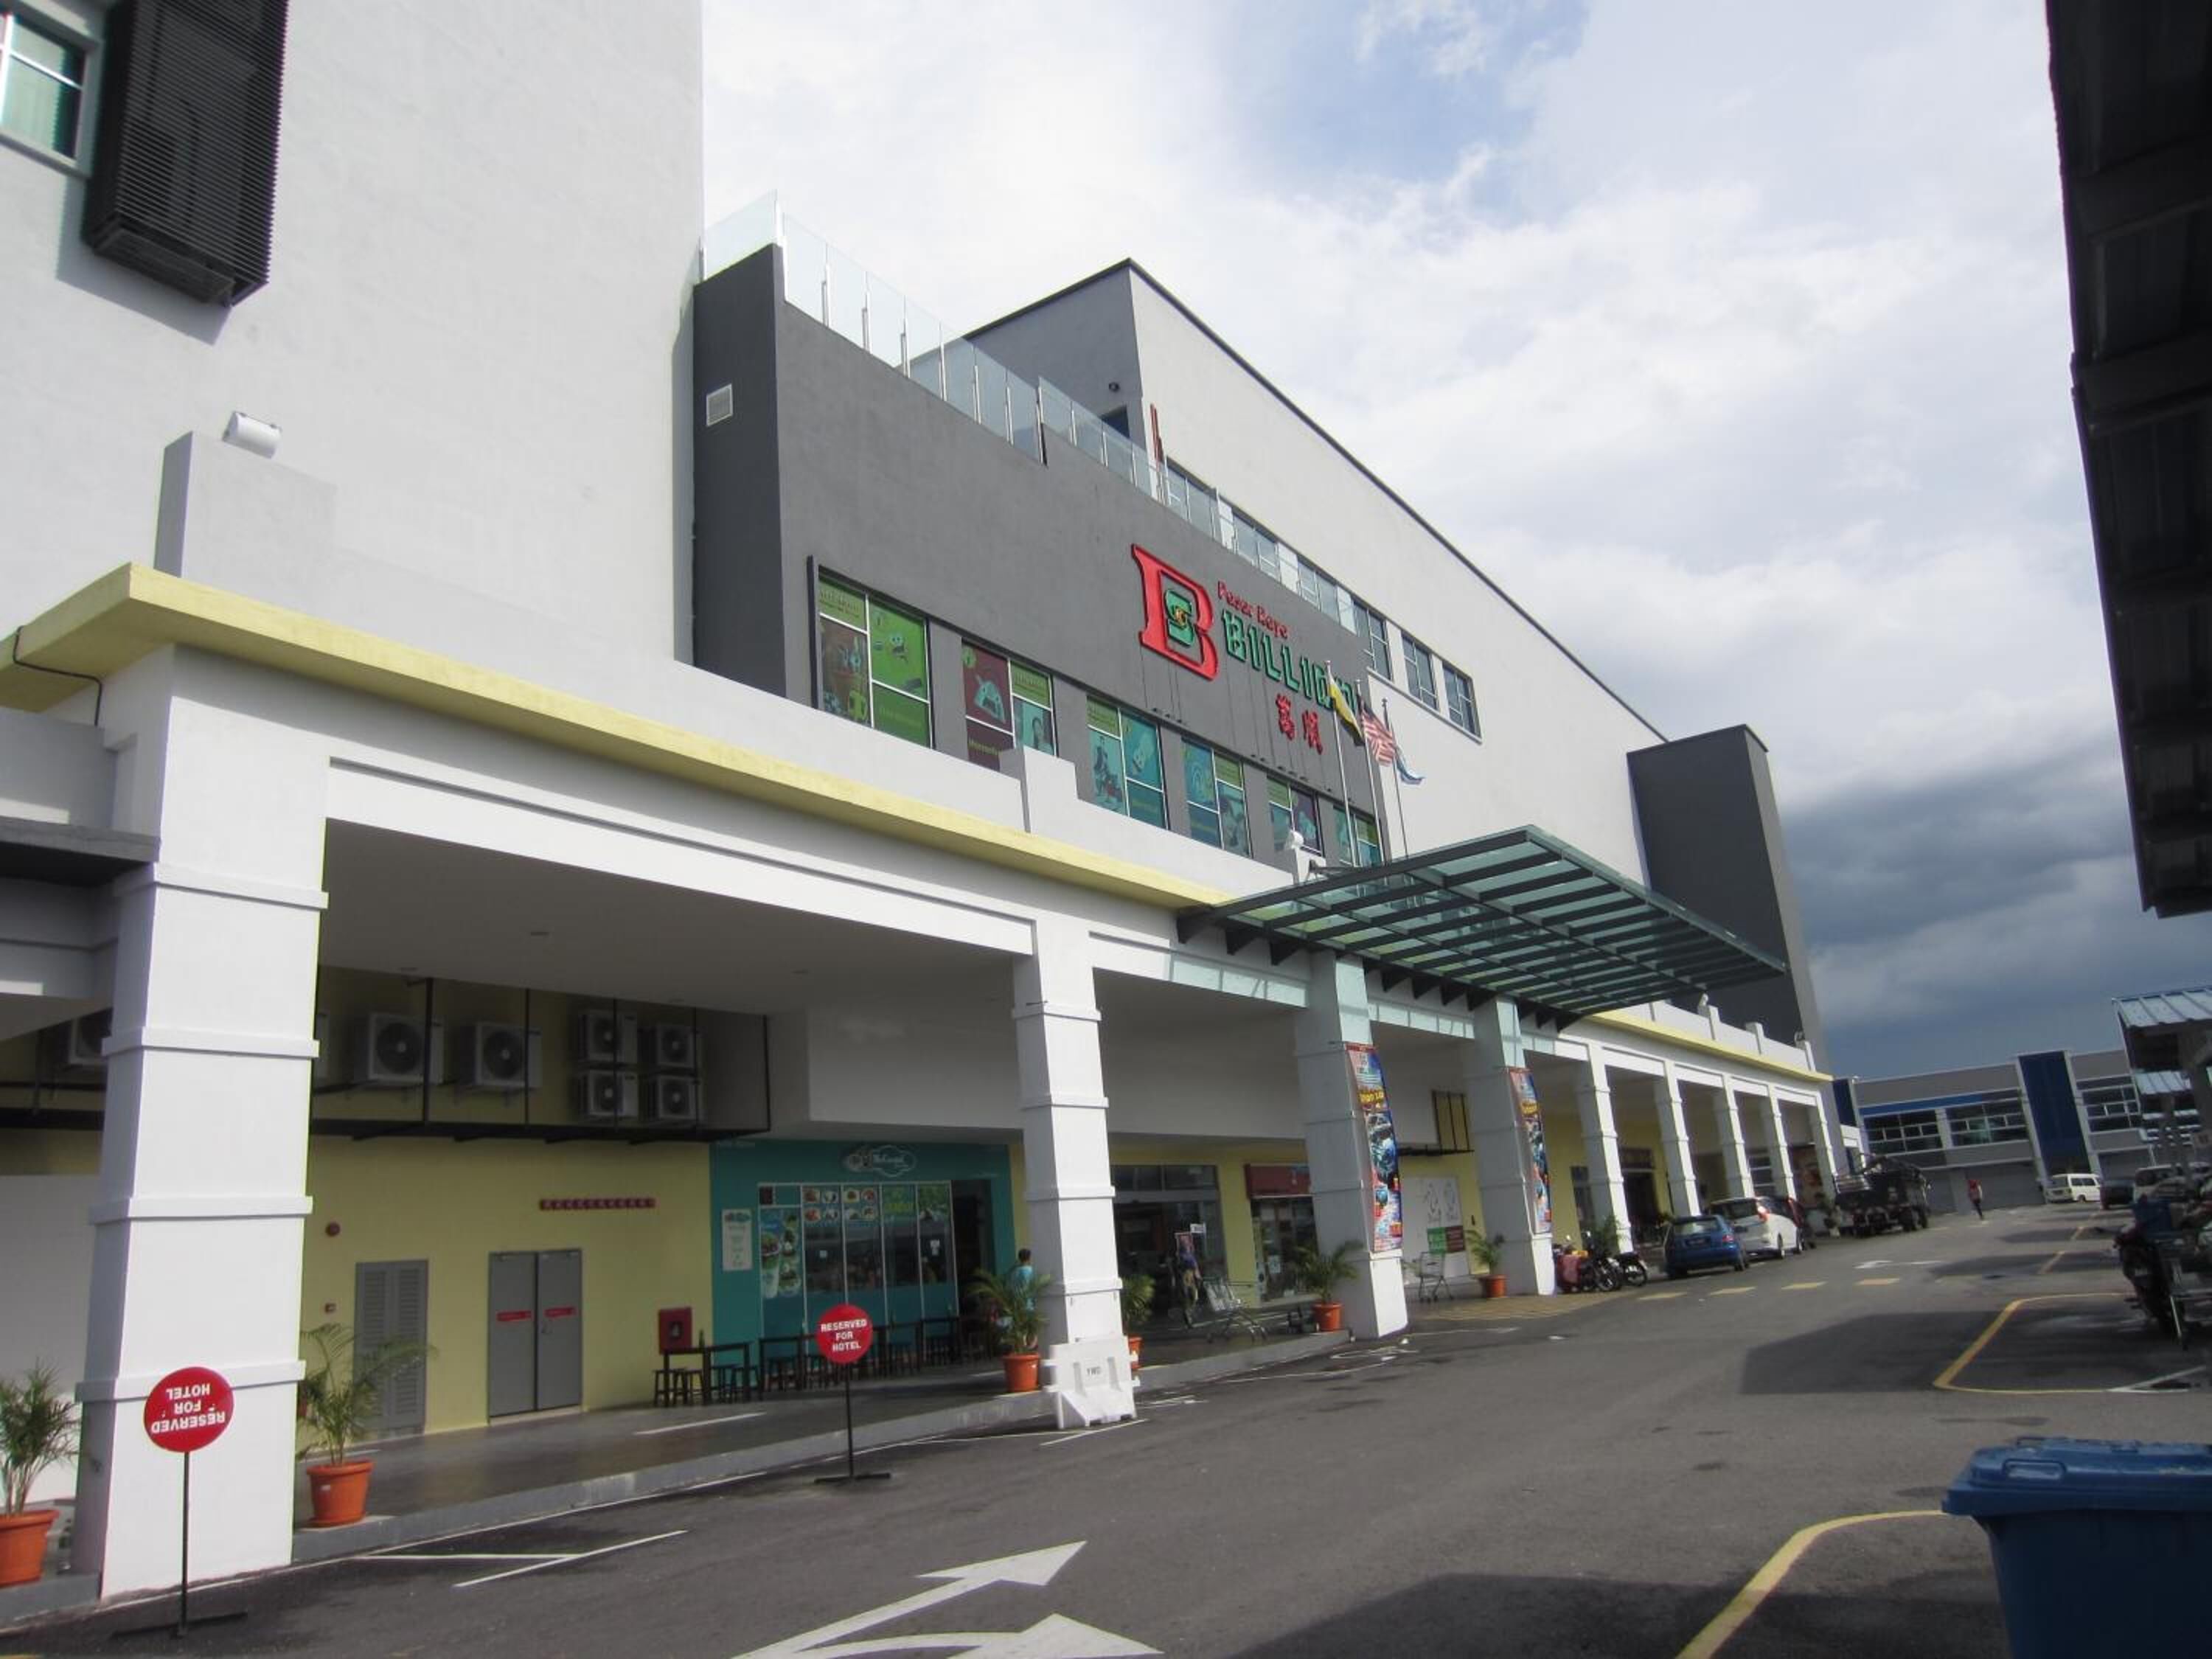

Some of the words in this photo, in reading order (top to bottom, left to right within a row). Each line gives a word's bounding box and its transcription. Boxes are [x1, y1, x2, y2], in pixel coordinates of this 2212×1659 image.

[1132, 544, 1219, 681] B
[820, 1318, 868, 1333] RESERVED
[835, 1330, 854, 1342] FOR
[832, 1340, 862, 1352] HOTEL
[165, 1382, 211, 1400] HOTEL
[173, 1399, 202, 1415] FOR
[150, 1411, 226, 1433] RESERVED
